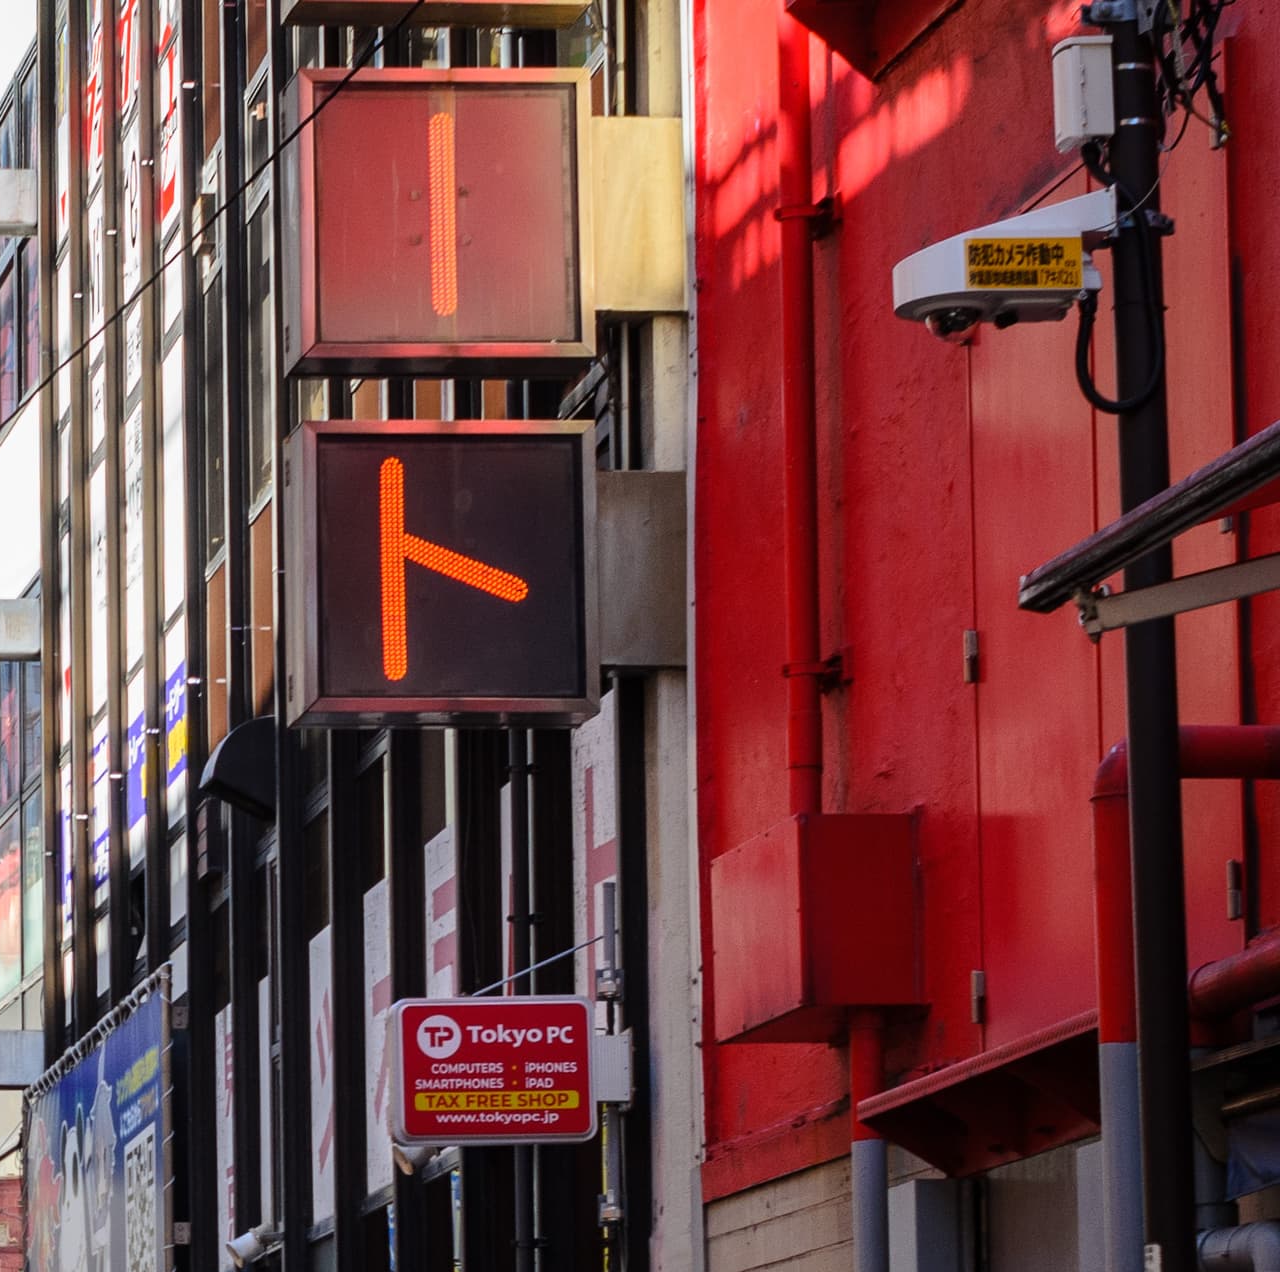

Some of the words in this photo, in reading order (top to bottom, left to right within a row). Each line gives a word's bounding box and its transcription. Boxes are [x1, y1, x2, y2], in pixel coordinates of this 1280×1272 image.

[466, 1024, 543, 1048] Tokyo
[547, 1025, 574, 1044] PC
[431, 1062, 504, 1075] COMPUTERS
[415, 1077, 504, 1090] SMARTPHONES
[525, 1077, 554, 1089] iPAD
[425, 1094, 460, 1109] TAX
[465, 1093, 512, 1108] FREE
[517, 1092, 570, 1107] SHOP
[436, 1111, 560, 1125] www.tokyopc.jp
